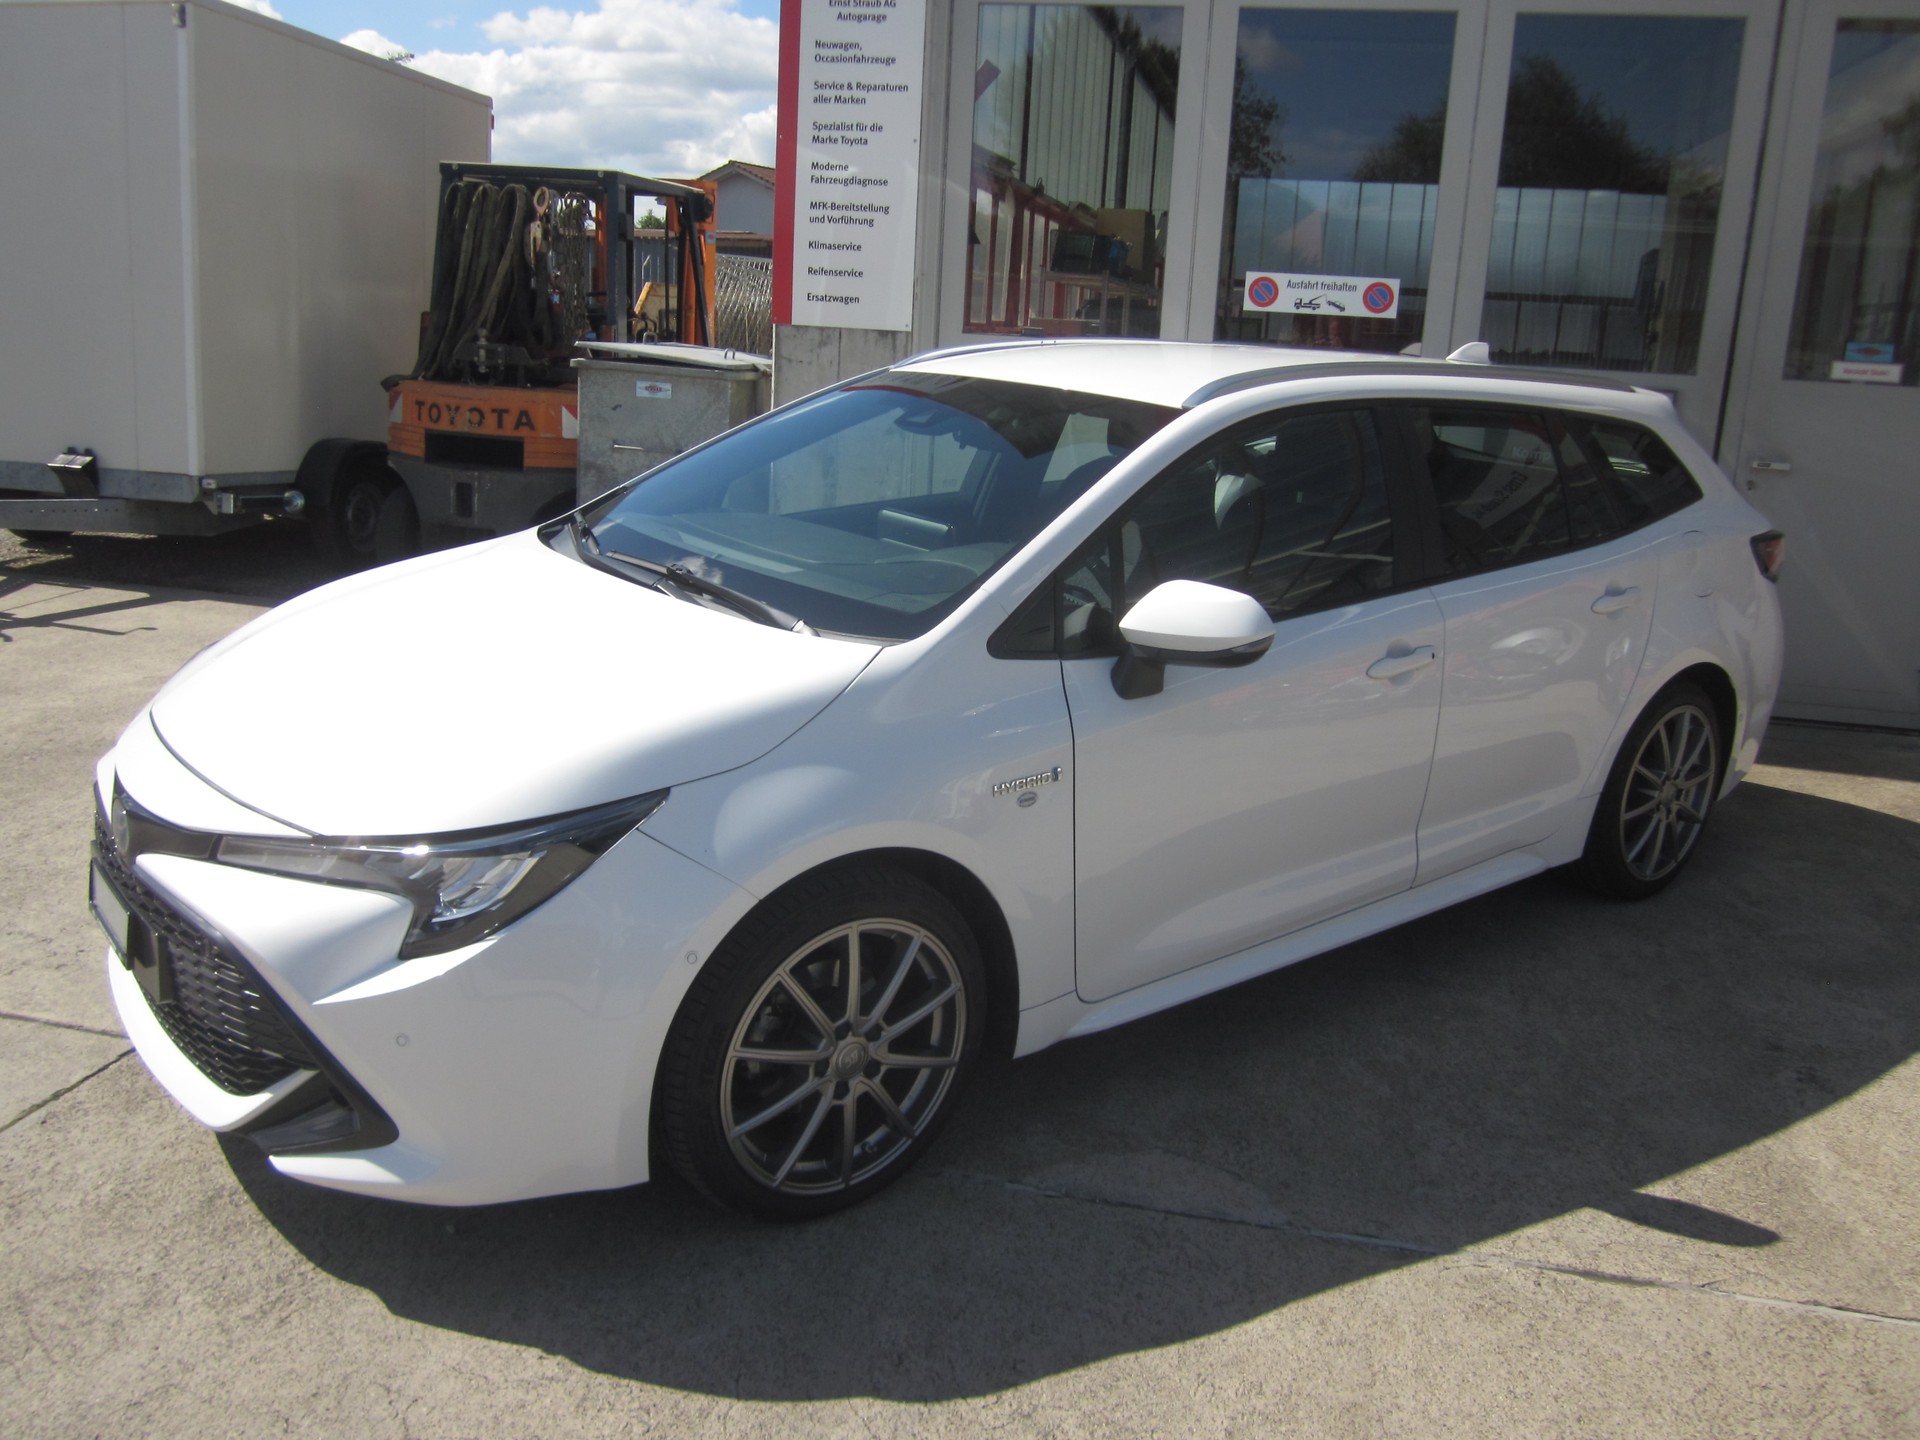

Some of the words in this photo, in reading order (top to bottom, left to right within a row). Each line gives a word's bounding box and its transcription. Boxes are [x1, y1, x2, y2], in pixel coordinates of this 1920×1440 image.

[829, 0, 851, 8] Ernst
[852, 0, 881, 8] Straub
[883, 0, 897, 8] AG
[837, 11, 887, 23] Autogarage
[815, 40, 862, 51] Neuwagen,
[814, 53, 896, 66] Occasionfahrzeuge
[813, 81, 845, 91] Service
[847, 82, 853, 91] &
[856, 82, 909, 93] Reparaturen
[813, 95, 832, 104] aller
[834, 95, 866, 105] Marken
[812, 121, 854, 133] Spezialist
[855, 122, 868, 132] für
[869, 122, 883, 132] die
[811, 135, 838, 145] Marke
[841, 135, 868, 147] Toyota
[811, 162, 849, 171] Moderne
[810, 175, 889, 187] Fahrzeugdiagnose
[809, 201, 890, 215] MFK-Bereitstellung
[809, 216, 825, 224] und
[827, 216, 874, 227] Vorführung
[808, 241, 862, 252] Klimaservice
[807, 267, 864, 278] Reifenservice
[1286, 279, 1318, 291] Ausfahrt
[1320, 281, 1357, 292] freihalten
[807, 293, 860, 305] Ersatzwagen
[415, 400, 536, 431] TOYOTA
[993, 772, 1051, 797] HYBRID
